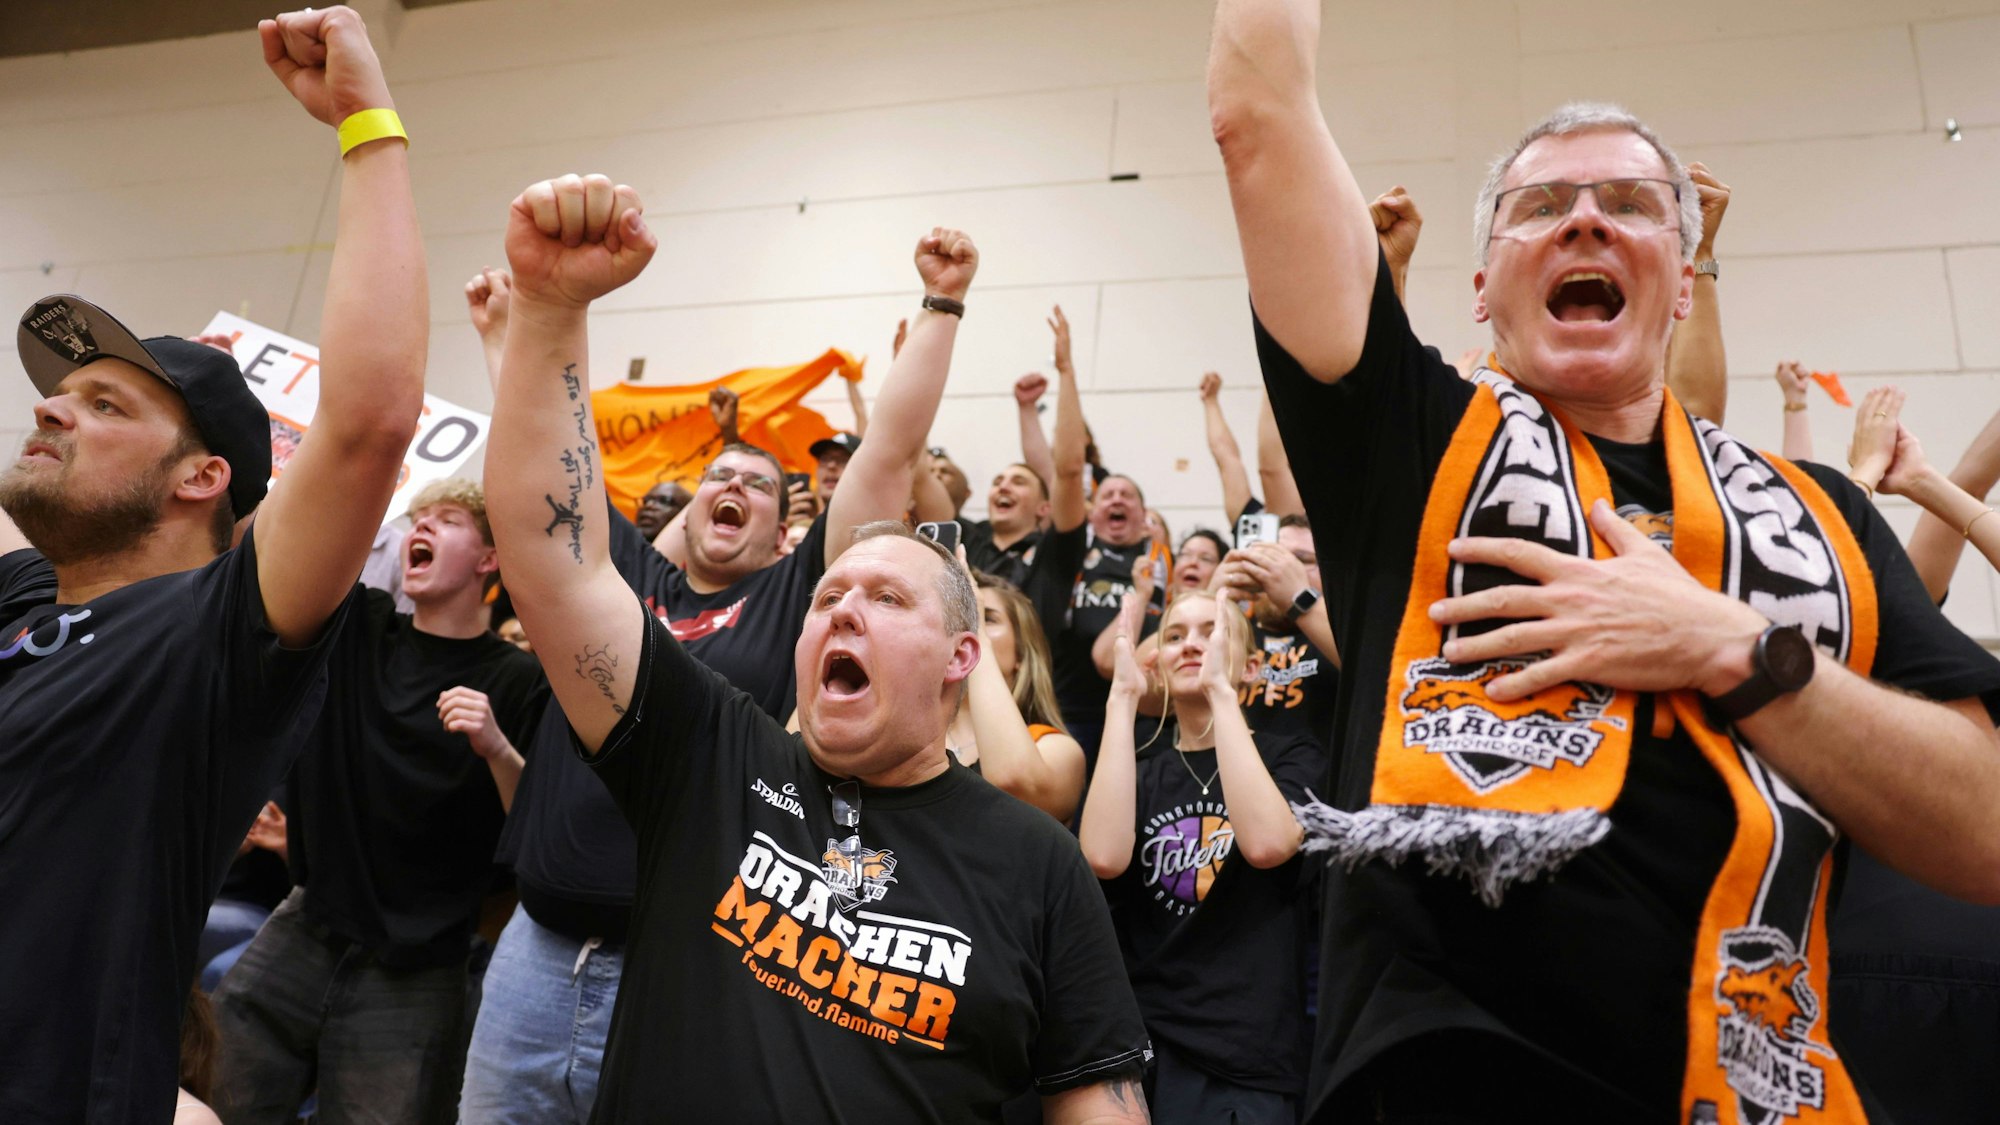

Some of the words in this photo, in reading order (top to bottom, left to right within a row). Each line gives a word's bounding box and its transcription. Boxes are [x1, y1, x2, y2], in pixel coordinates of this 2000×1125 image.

[30, 304, 66, 329] RAIDERS
[231, 331, 319, 395] ET
[413, 403, 479, 463] O
[1410, 713, 1590, 759] DRAGONS
[714, 876, 956, 1041] MACHER
[739, 843, 972, 986] DRACHEN
[741, 950, 900, 1045] feuer.und.flamme
